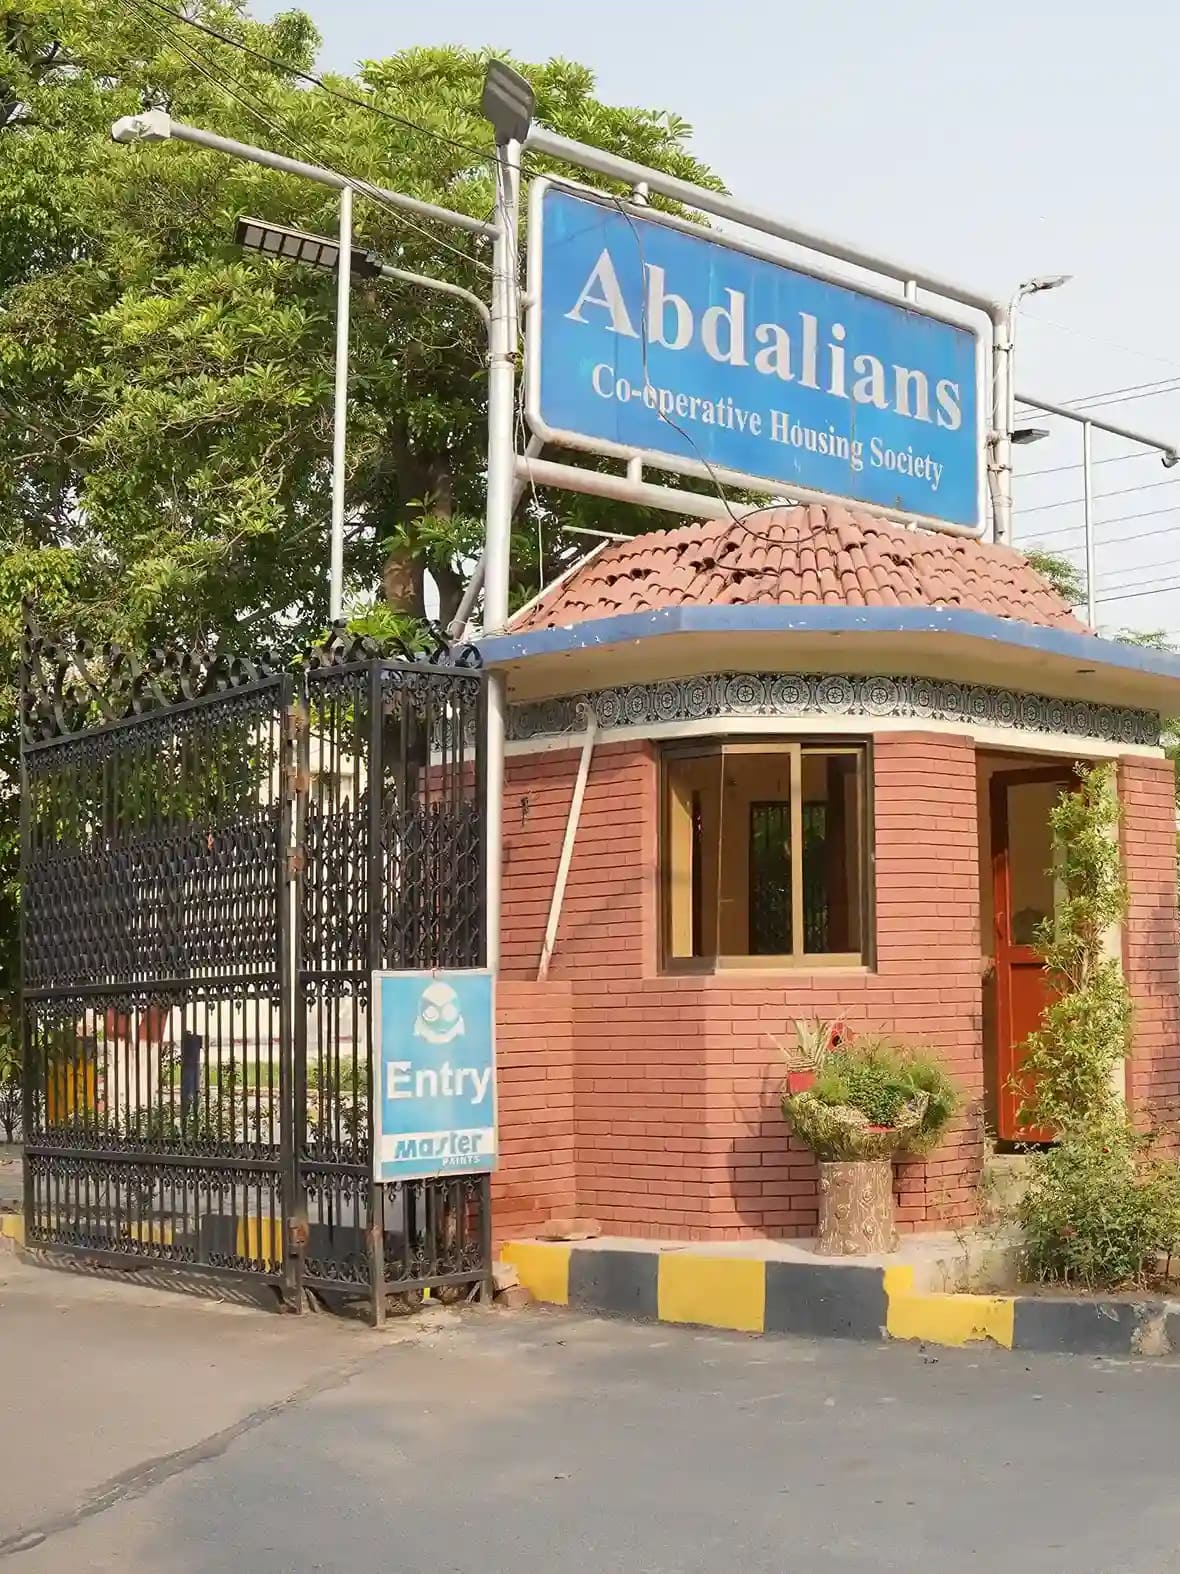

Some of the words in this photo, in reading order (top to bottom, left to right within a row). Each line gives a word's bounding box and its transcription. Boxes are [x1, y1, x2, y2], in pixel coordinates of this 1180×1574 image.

[563, 247, 962, 432] Abdalians
[592, 363, 762, 436] Co-operative
[769, 408, 864, 472] Housing
[870, 436, 944, 491] Society
[386, 1060, 492, 1104] Entry
[442, 1154, 480, 1167] PAINTS
